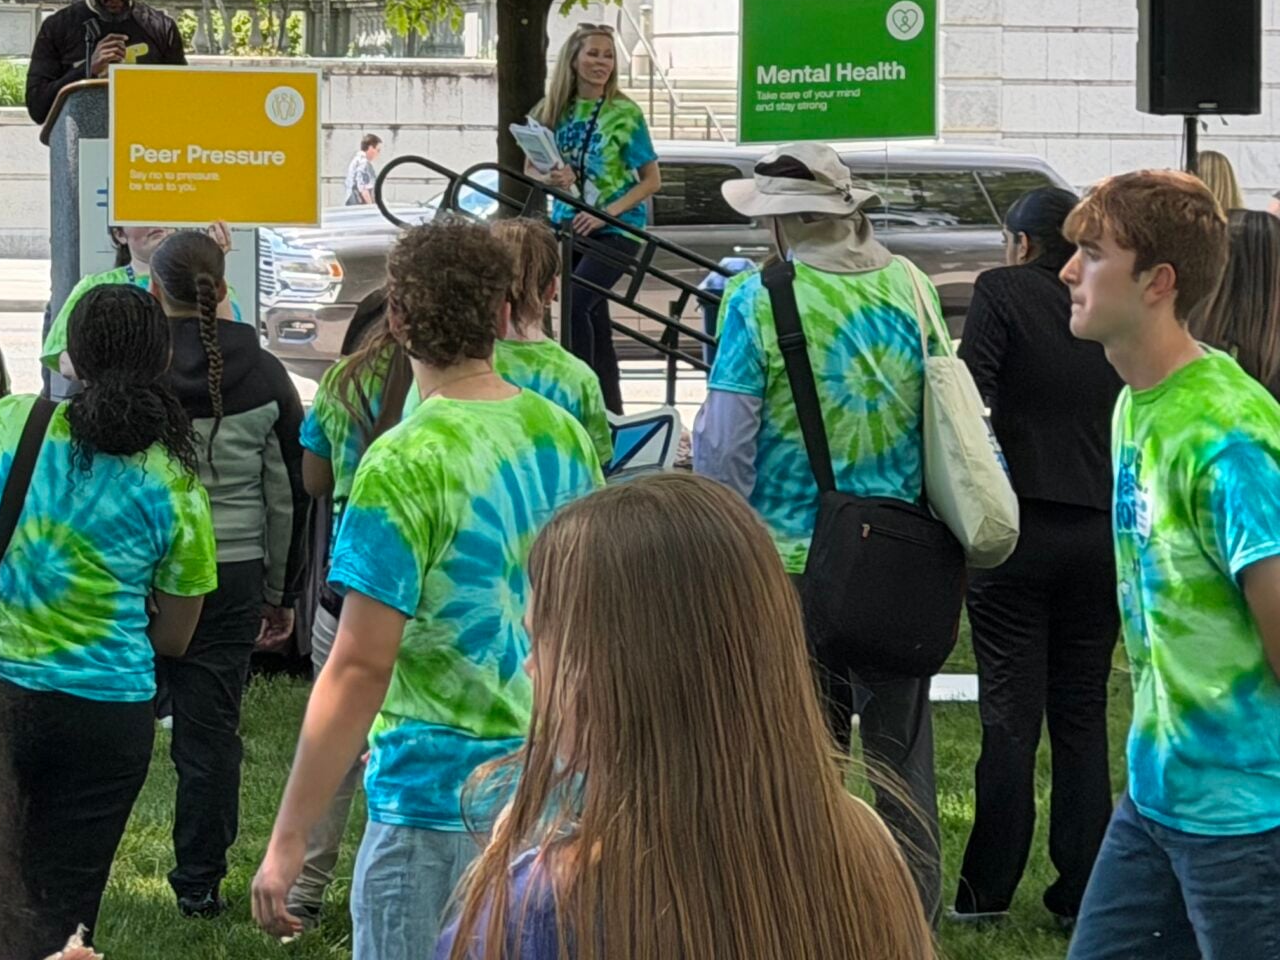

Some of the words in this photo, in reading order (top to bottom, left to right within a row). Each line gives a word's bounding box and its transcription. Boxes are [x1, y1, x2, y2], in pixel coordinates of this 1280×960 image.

[756, 63, 831, 85] Mental
[836, 61, 906, 82] Health
[756, 90, 778, 100] Take
[780, 91, 801, 100] care
[802, 89, 813, 99] of
[814, 90, 834, 100] your
[836, 88, 861, 98] mind
[755, 102, 774, 112] and
[775, 102, 796, 113] stay
[797, 101, 828, 112] strong
[129, 143, 181, 164] Peer
[187, 144, 286, 165] Pressure
[129, 169, 147, 181] Say
[148, 172, 163, 180] no
[129, 182, 142, 191] be
[144, 183, 165, 191] true
[166, 182, 177, 191] to
